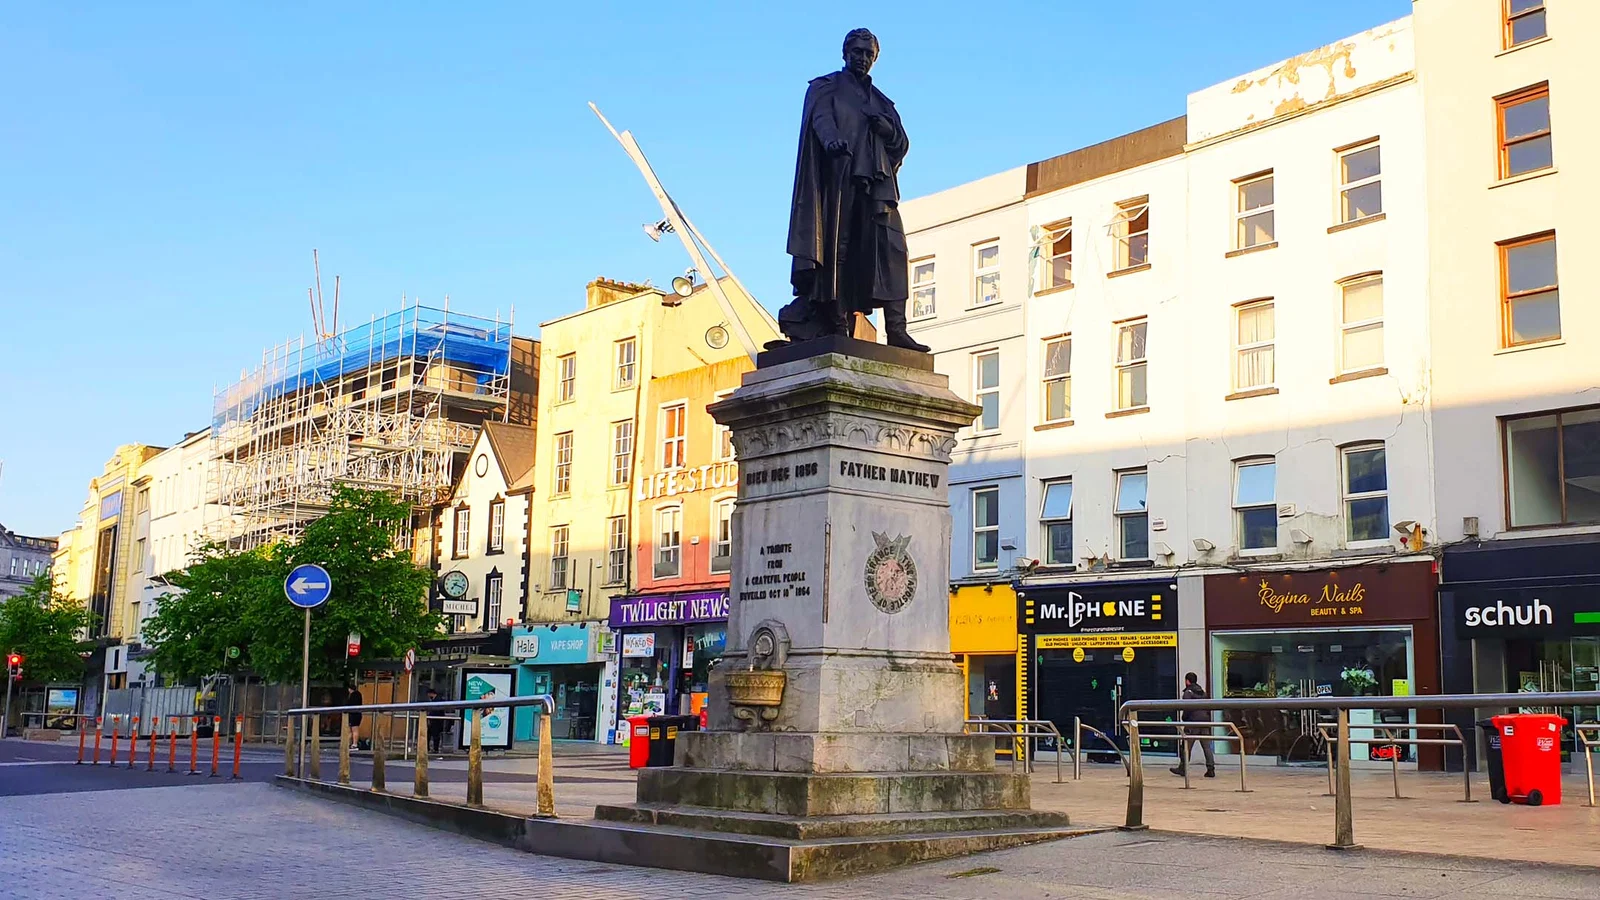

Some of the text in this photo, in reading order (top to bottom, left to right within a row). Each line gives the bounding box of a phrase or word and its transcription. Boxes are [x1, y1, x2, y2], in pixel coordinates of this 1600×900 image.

[840, 460, 940, 489] FATHER MATHEW
[760, 543, 792, 555] A TRIBUTE
[767, 559, 783, 569] FROM
[902, 555, 914, 576] THE
[745, 571, 805, 586] A GRATEFUL PEOPLE
[769, 589, 781, 598] OCT
[890, 580, 915, 610] APOSTLE
[1258, 583, 1365, 613] Regina Nails
[445, 603, 474, 611] MICHEL
[621, 593, 730, 623] TWILIGHT NEWS
[1040, 603, 1068, 619] Mr.
[1310, 606, 1363, 616] BEAUTY & SPA
[1465, 599, 1552, 626] schuh
[517, 639, 584, 652] Hale VAPE SHOP
